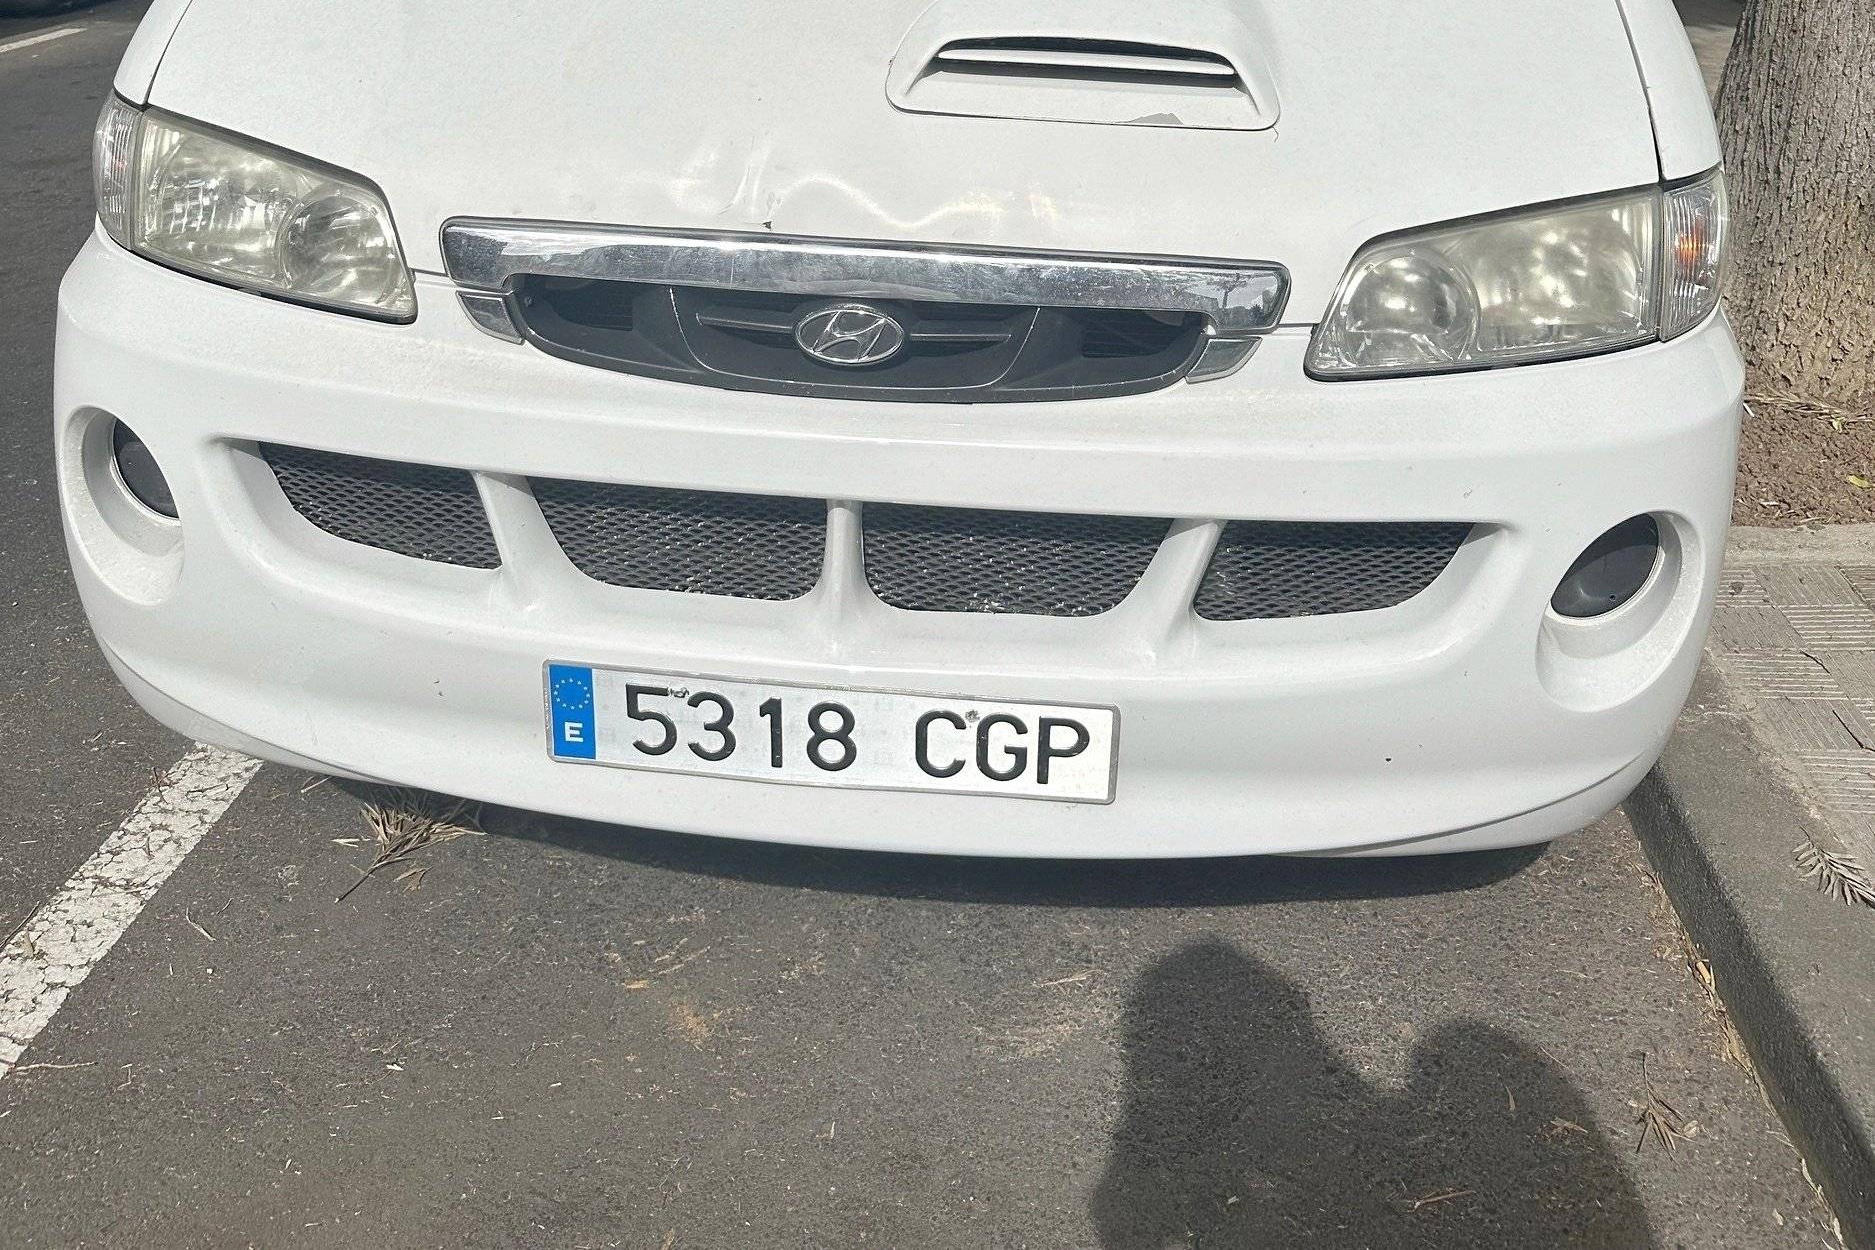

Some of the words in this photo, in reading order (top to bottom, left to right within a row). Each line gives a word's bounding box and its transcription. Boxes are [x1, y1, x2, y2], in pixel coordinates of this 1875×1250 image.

[564, 721, 584, 743] E
[624, 682, 858, 772] 5318
[914, 708, 1091, 785] CGP
